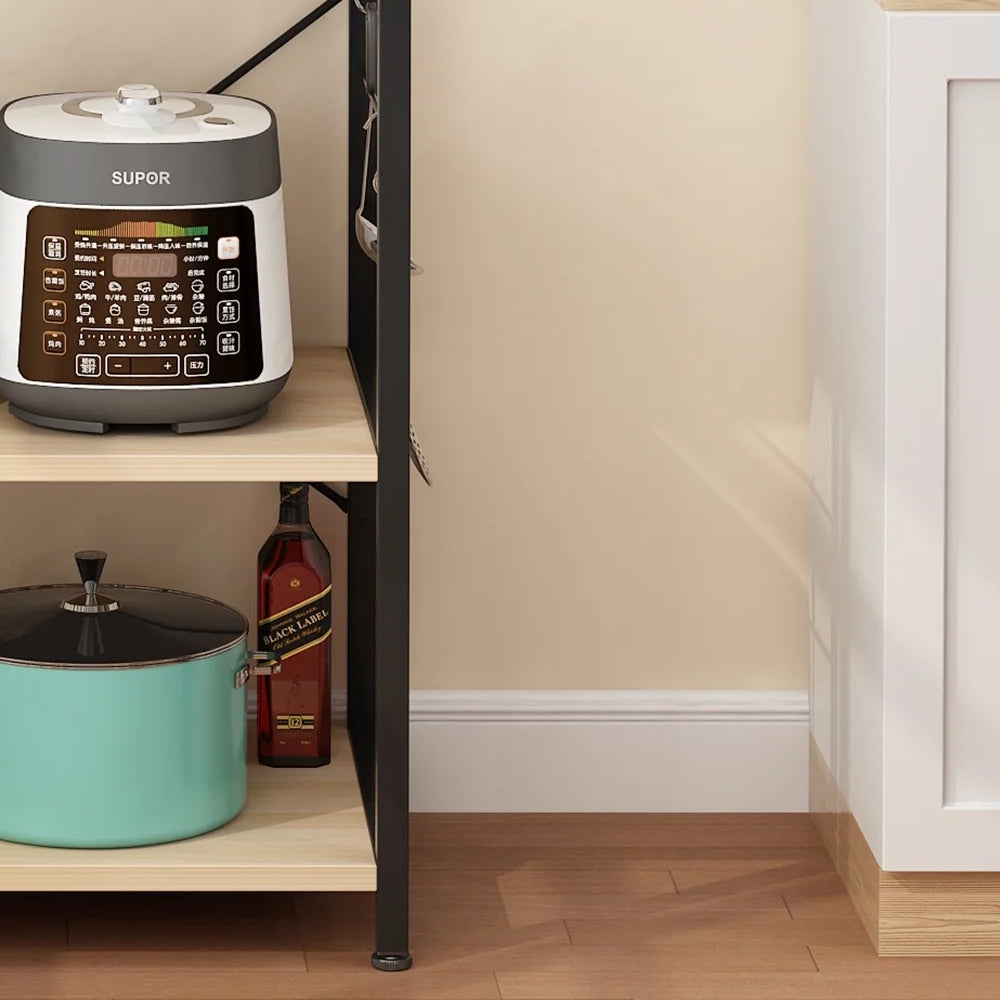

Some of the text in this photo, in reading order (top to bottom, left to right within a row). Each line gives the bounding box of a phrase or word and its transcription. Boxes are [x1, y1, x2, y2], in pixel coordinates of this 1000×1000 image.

[112, 171, 171, 185] SUPOR
[118, 340, 126, 348] 30
[189, 361, 204, 369] 压力
[263, 609, 329, 645] BLACK LABEL
[291, 718, 300, 727] 12
